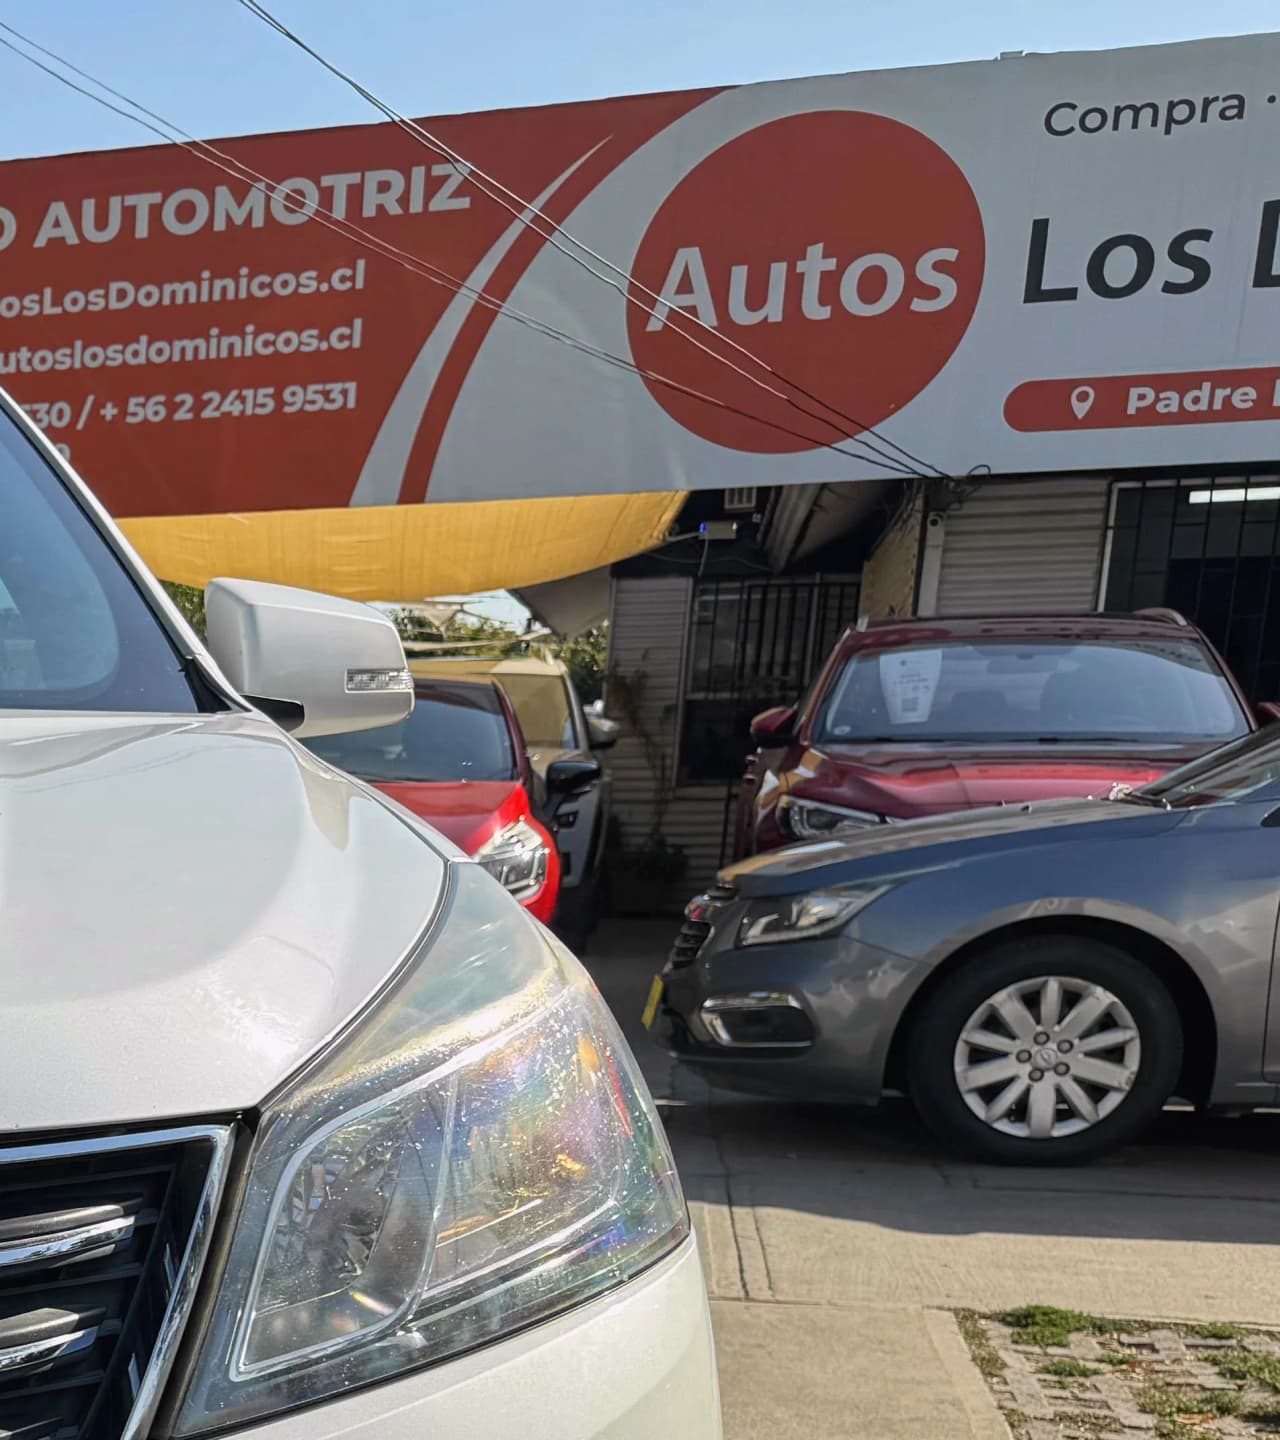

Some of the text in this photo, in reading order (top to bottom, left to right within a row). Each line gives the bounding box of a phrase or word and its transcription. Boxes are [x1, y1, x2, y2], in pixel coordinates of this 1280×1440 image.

[1044, 93, 1246, 136] Compra
[33, 161, 472, 249] AUTOMOTRIZ
[645, 242, 959, 332] Autos
[1023, 217, 1214, 304] Los
[125, 394, 167, 424] 56
[173, 393, 195, 421] 2
[200, 387, 276, 419] 2415
[282, 381, 358, 413] 9531
[1126, 381, 1258, 415] Padre
